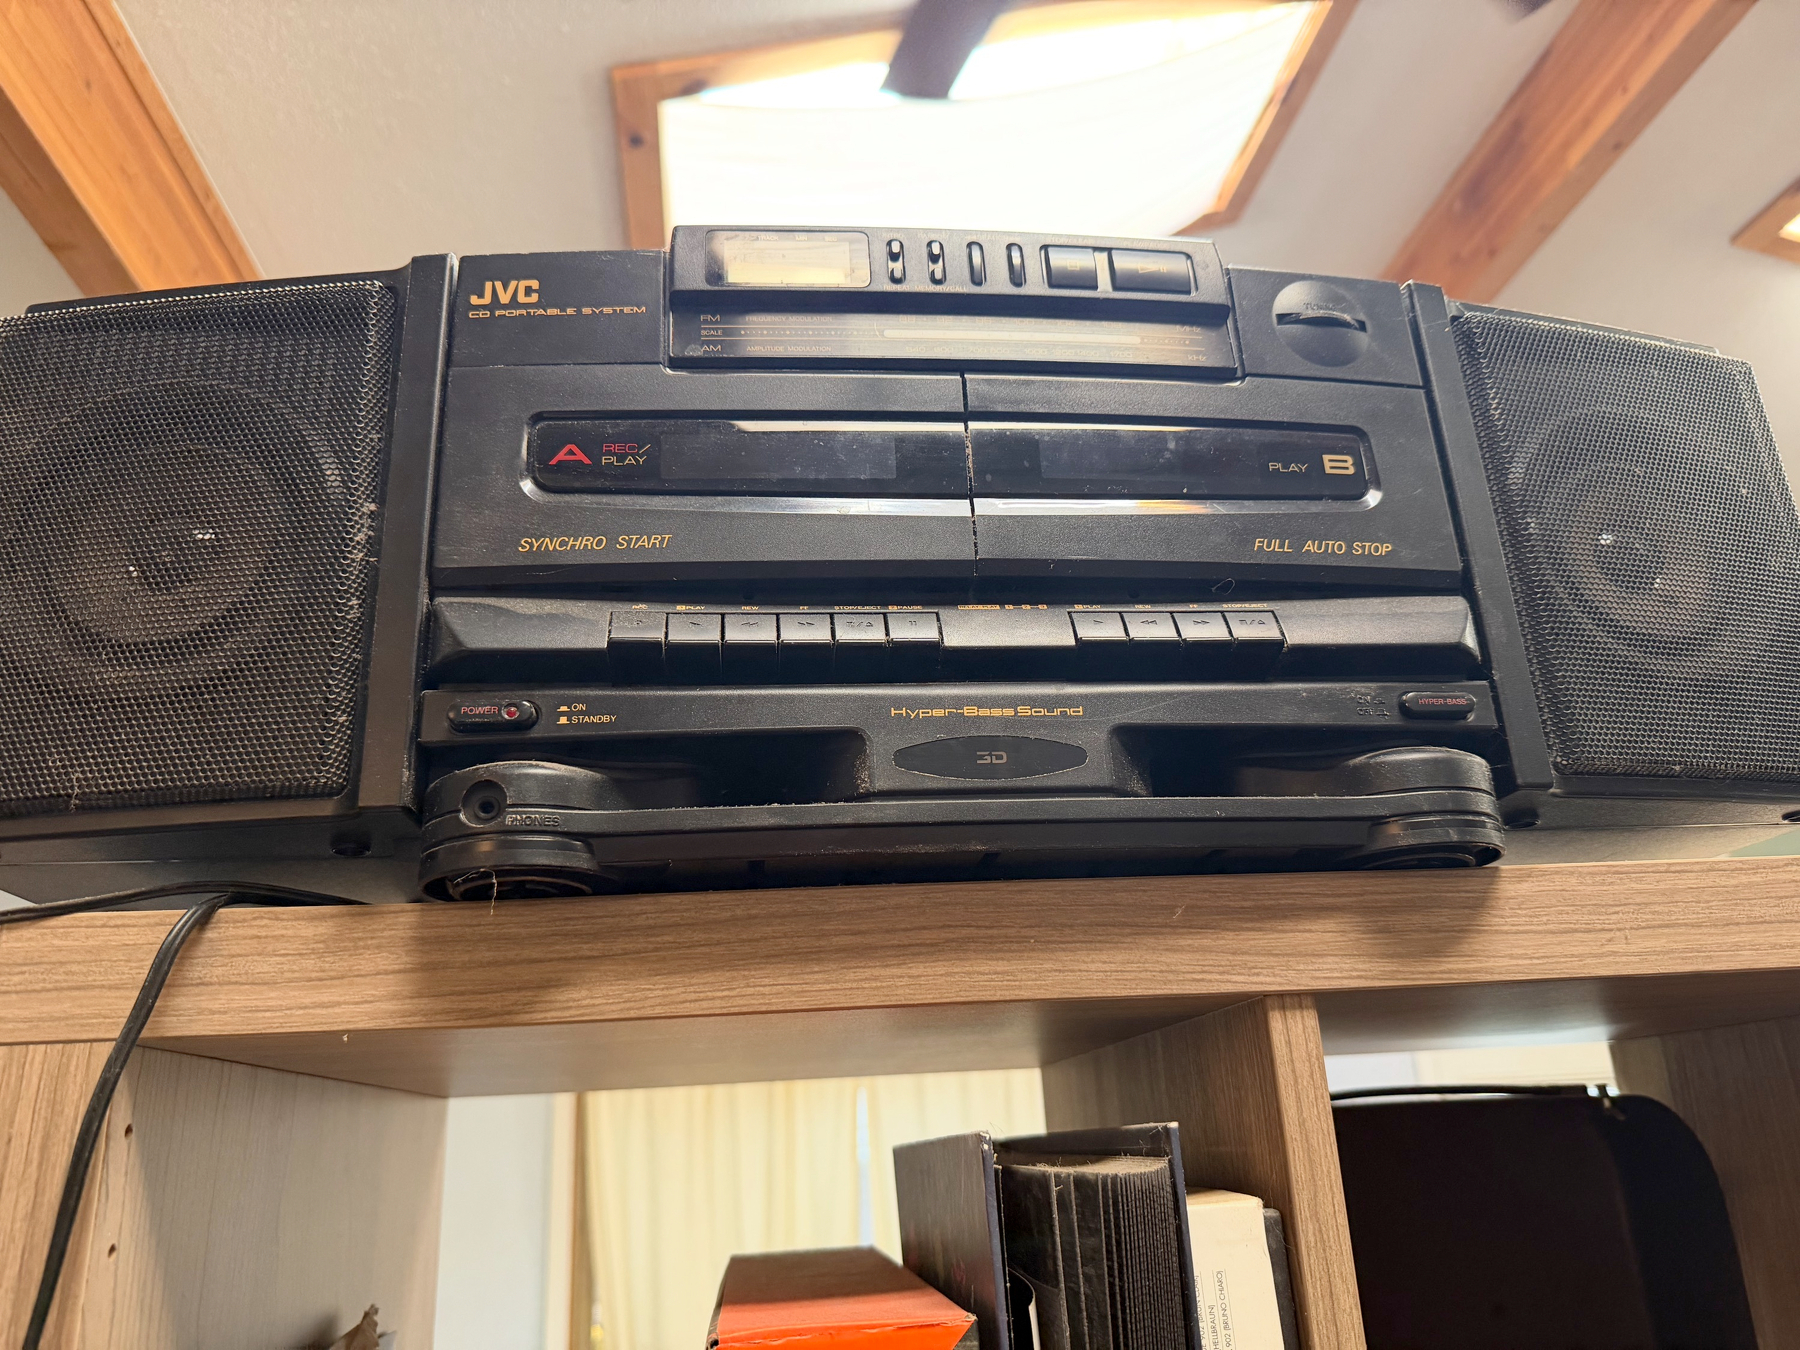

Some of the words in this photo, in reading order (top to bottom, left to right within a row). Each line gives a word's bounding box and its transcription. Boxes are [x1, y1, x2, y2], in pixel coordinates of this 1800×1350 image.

[470, 279, 540, 306] JVC
[495, 308, 577, 318] PORTABLE
[582, 306, 646, 316] SYSTEM
[701, 314, 721, 322] FM
[745, 315, 787, 323] FREQUENCY
[789, 315, 833, 323] MODULATION
[701, 344, 722, 352] AM
[549, 444, 592, 465] A
[602, 456, 647, 466] PLAY
[1322, 454, 1355, 475] B
[1269, 462, 1308, 473] PLAY
[518, 535, 607, 552] SYNCHRO
[616, 535, 672, 549] START
[1254, 538, 1293, 552] FULL
[1302, 540, 1346, 555] AUTO
[1352, 542, 1392, 556] STOP
[461, 706, 499, 715] POWER
[571, 703, 587, 712] ON
[891, 706, 1015, 719] Hyper-Bass
[1017, 706, 1083, 716] Sound
[571, 715, 617, 724] STANDBY
[976, 751, 1008, 764] 3D
[505, 814, 560, 827] PHONES
